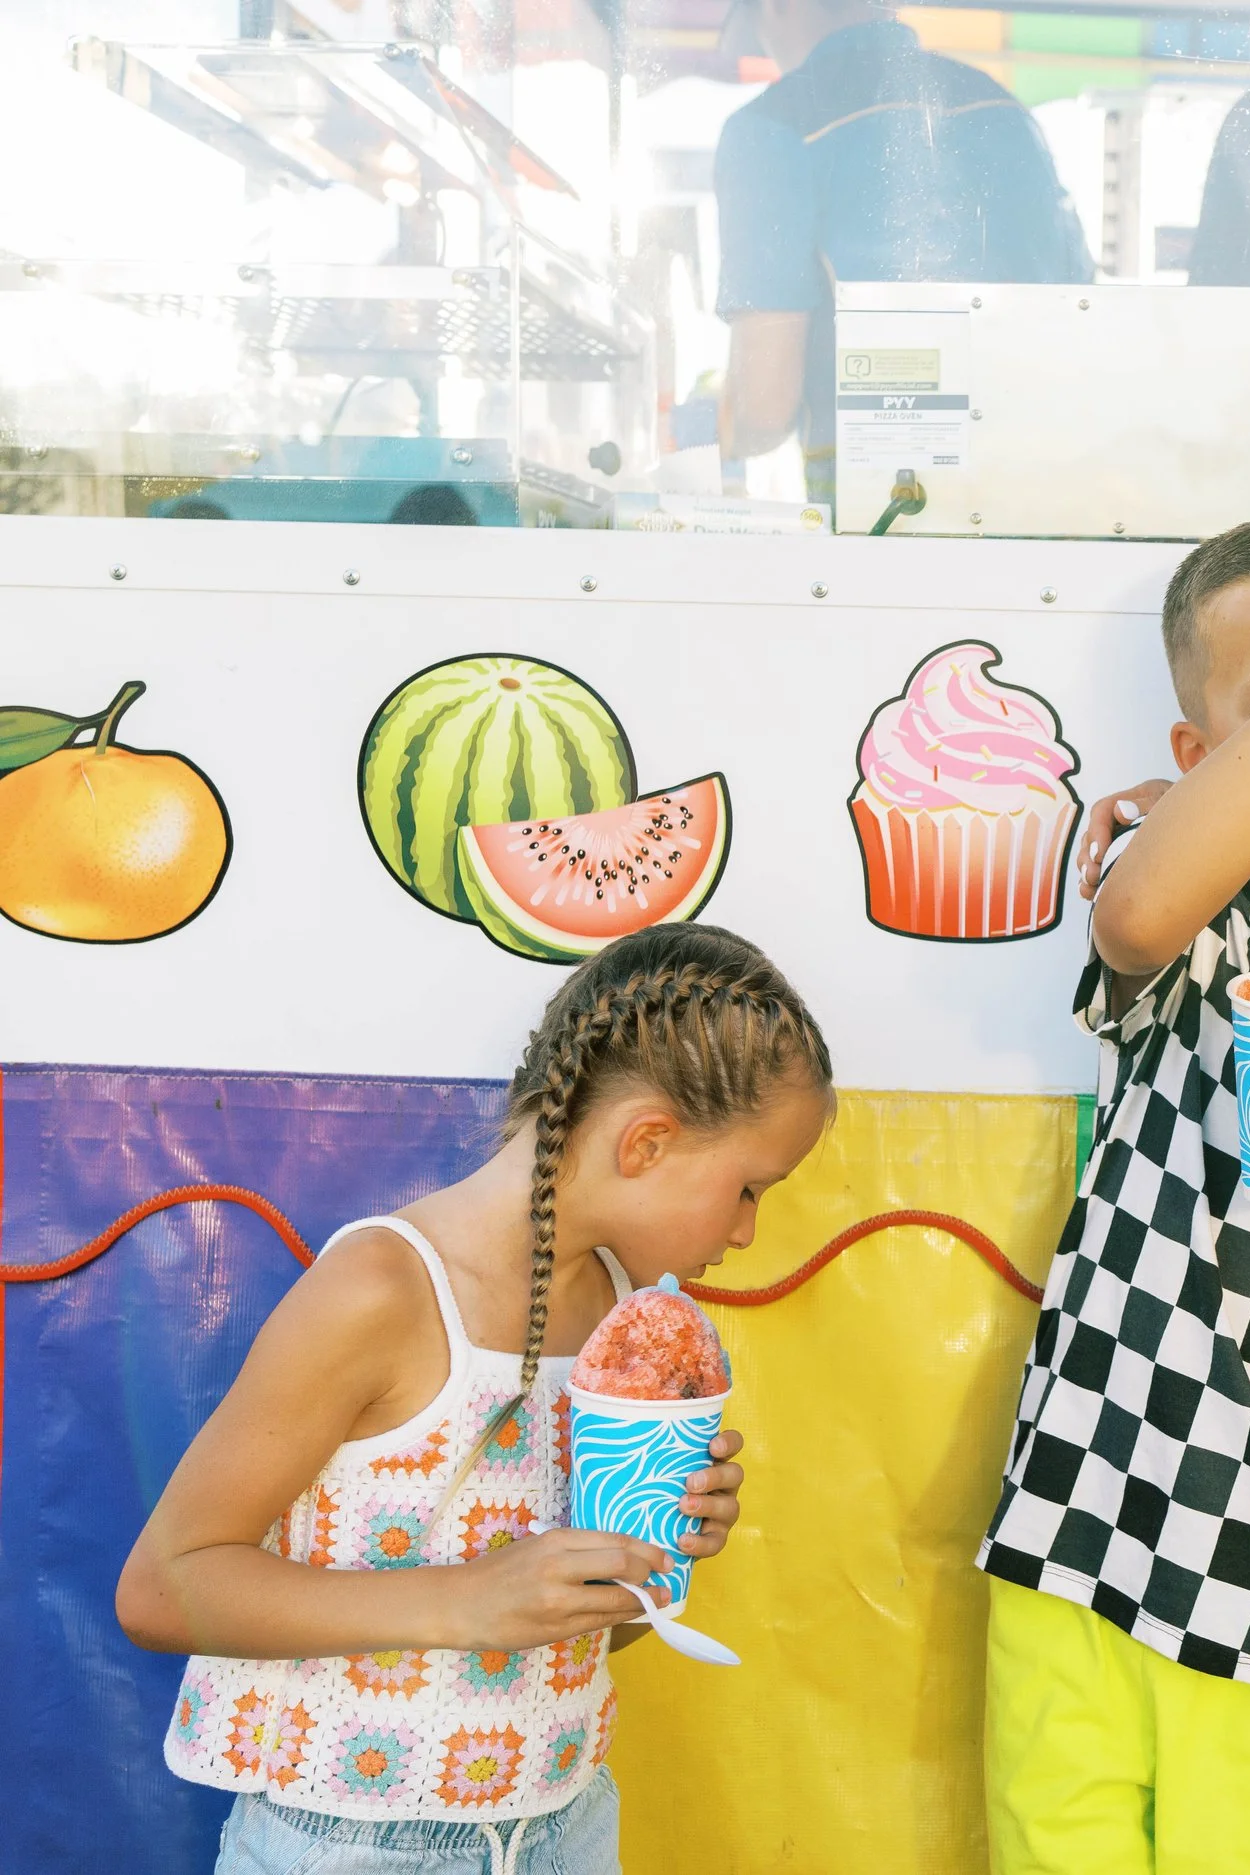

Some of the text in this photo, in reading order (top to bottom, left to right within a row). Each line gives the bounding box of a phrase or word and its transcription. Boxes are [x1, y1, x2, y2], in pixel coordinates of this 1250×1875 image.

[883, 396, 916, 409] PYY
[874, 412, 923, 420] PIZZA OVEN
